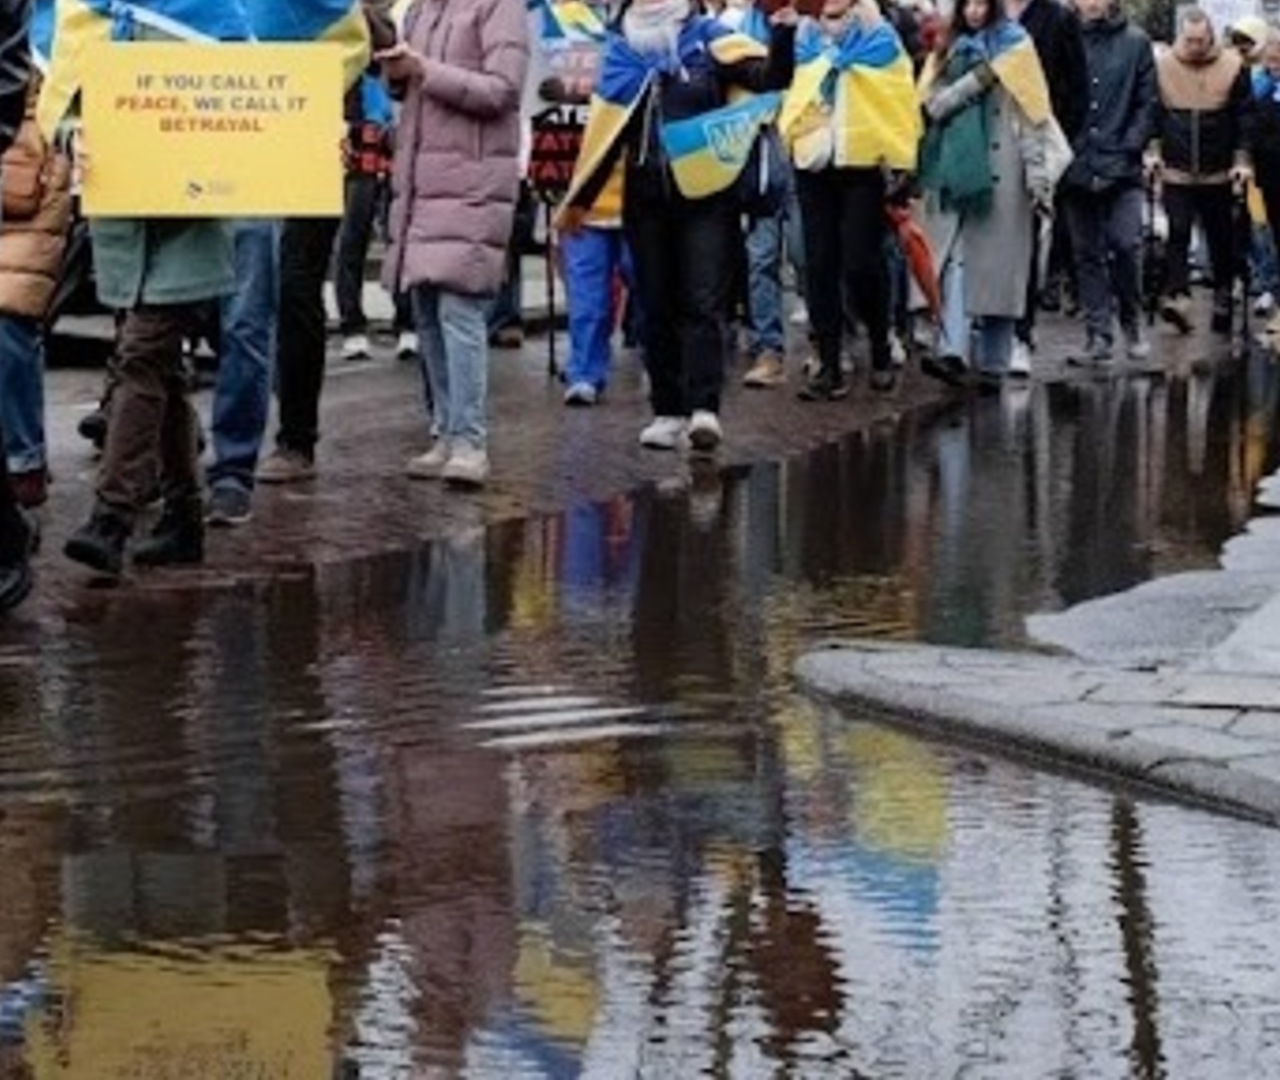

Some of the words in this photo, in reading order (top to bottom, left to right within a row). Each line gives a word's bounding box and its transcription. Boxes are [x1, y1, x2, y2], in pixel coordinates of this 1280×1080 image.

[136, 74, 153, 90] IF
[163, 74, 203, 90] YOU
[209, 74, 261, 90] CALL
[267, 74, 288, 90] IT
[114, 96, 189, 113] PEACE,
[193, 96, 224, 112] WE
[230, 96, 281, 112] CALL
[287, 96, 308, 112] IT
[158, 119, 263, 133] BETRAYAL
